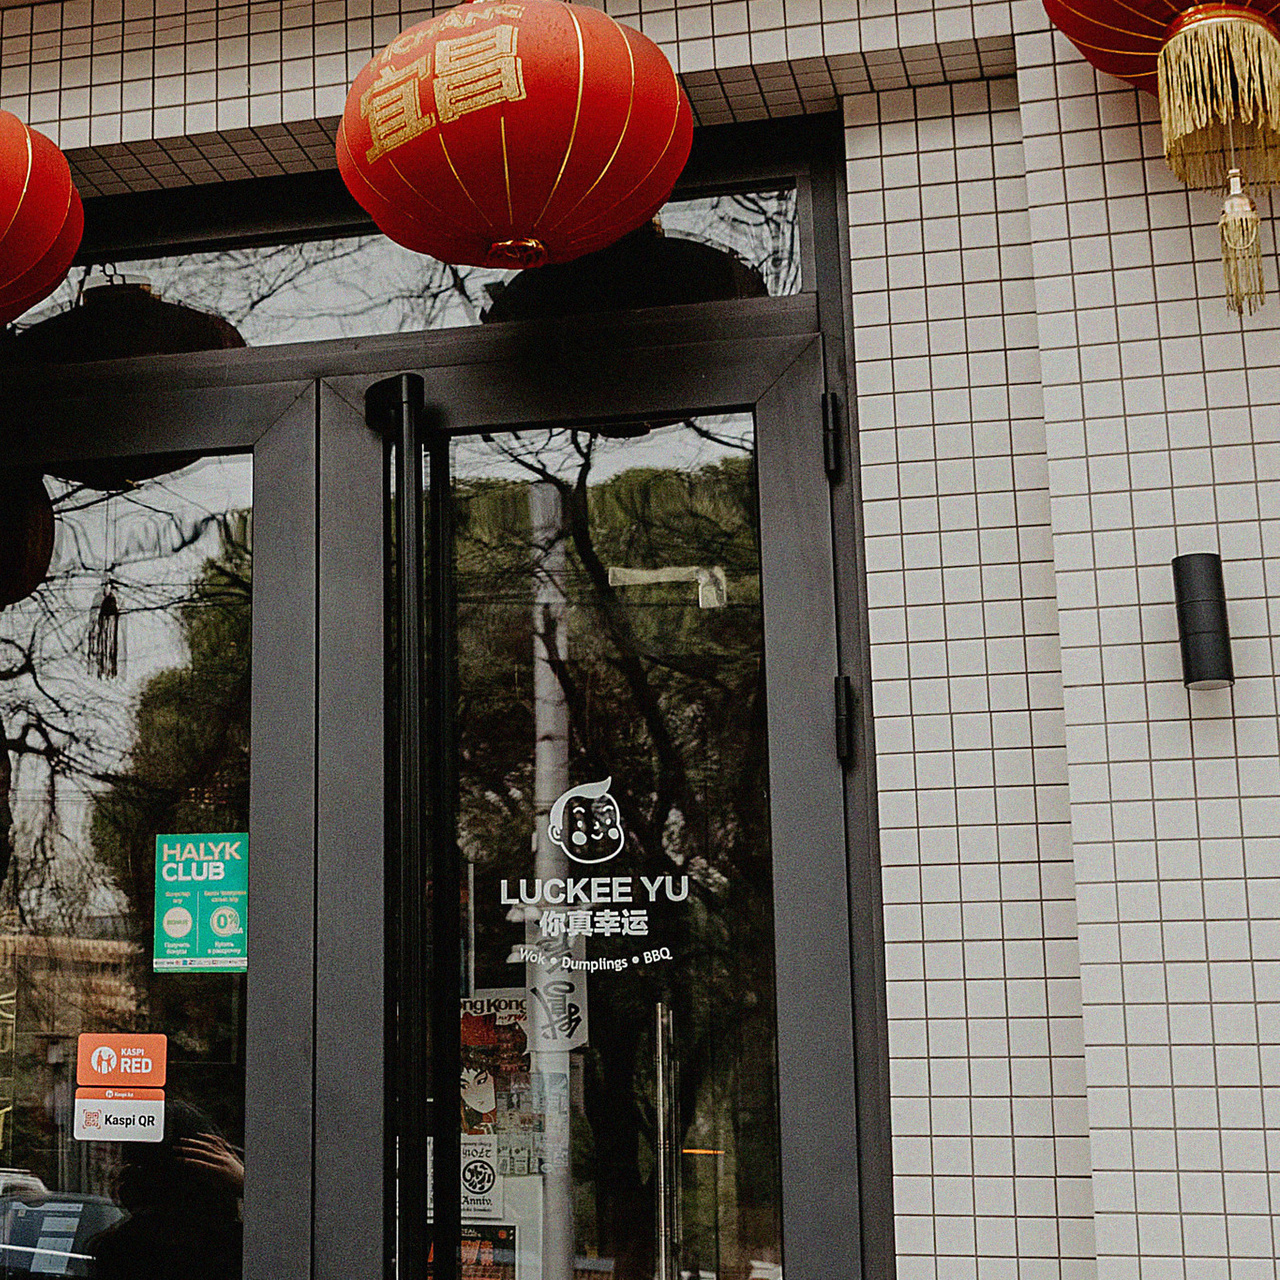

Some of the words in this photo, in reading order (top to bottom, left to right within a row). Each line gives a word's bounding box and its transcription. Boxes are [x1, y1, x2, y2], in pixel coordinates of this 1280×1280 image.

[360, 24, 527, 165] 宜昌
[163, 841, 242, 862] HALYK
[162, 861, 225, 882] CLUB
[500, 876, 634, 904] LUCKEE
[640, 875, 689, 902] YU
[539, 908, 649, 937] 你真幸运
[520, 948, 546, 965] Wok
[561, 956, 628, 974] Dumplings
[643, 947, 673, 964] BBQ
[461, 999, 485, 1014] ng
[121, 1048, 145, 1056] KASPI
[120, 1058, 153, 1074] RED
[104, 1114, 136, 1128] Kaspi
[138, 1115, 156, 1128] QR
[461, 1195, 493, 1206] Anniv.
